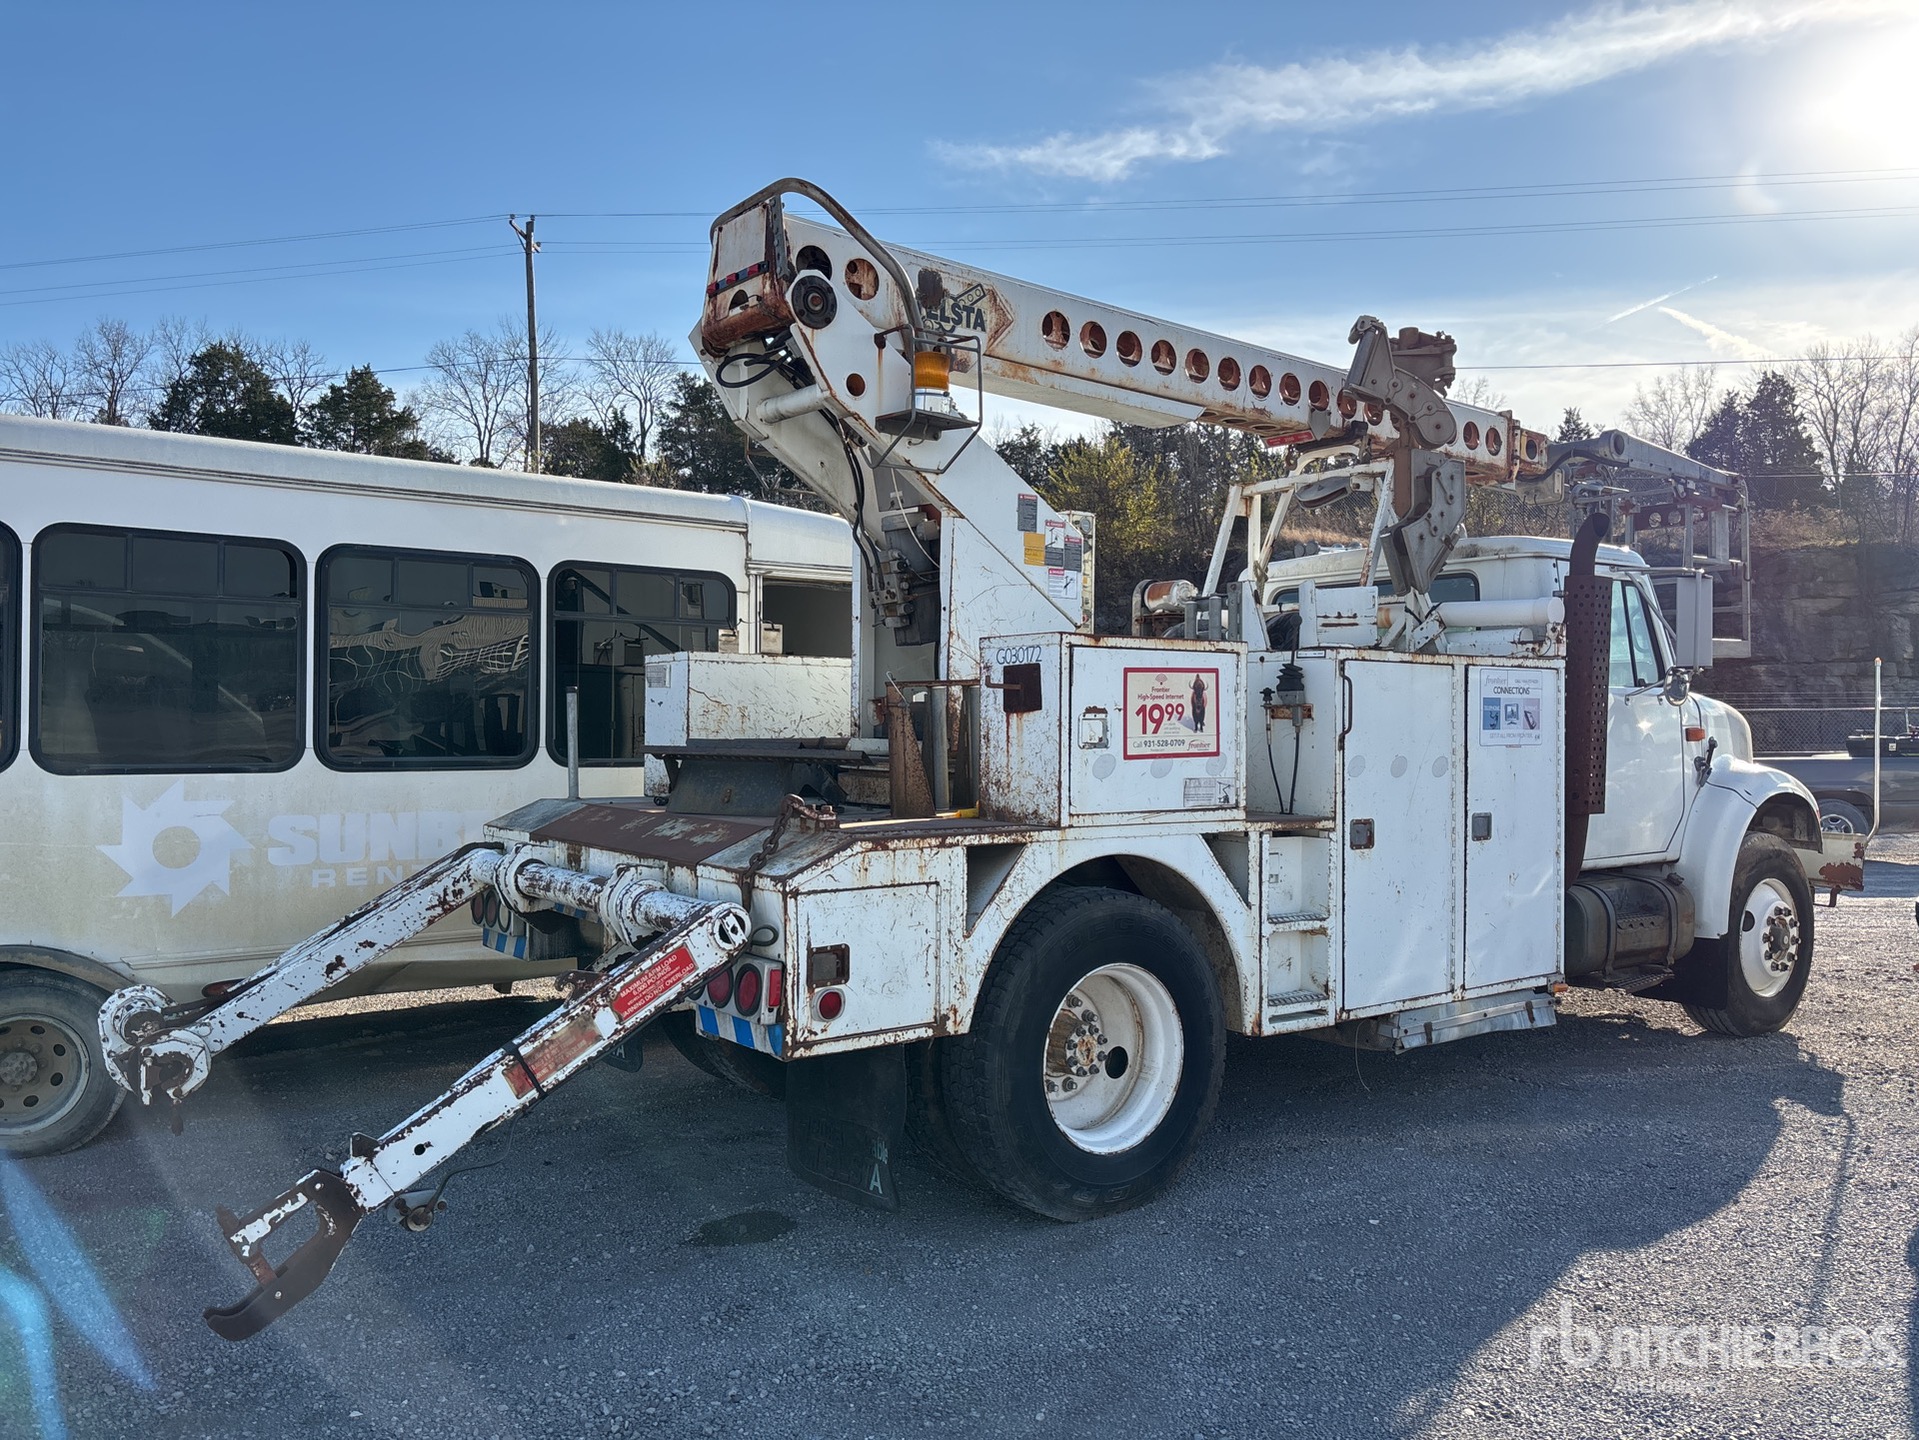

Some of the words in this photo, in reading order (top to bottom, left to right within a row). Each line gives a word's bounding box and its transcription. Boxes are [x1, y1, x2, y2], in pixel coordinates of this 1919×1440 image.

[919, 297, 986, 333] ELSTA
[1493, 686, 1530, 695] CONNECTIONS
[1143, 740, 1186, 748] 931-528-0709
[267, 809, 492, 867] SUNB
[619, 974, 649, 997] MAXIMUM
[660, 954, 677, 968] LOAD
[643, 991, 654, 1001] DO
[652, 983, 666, 995] NOT
[663, 962, 694, 987] OVERLOAD
[646, 965, 672, 985] POUNDS
